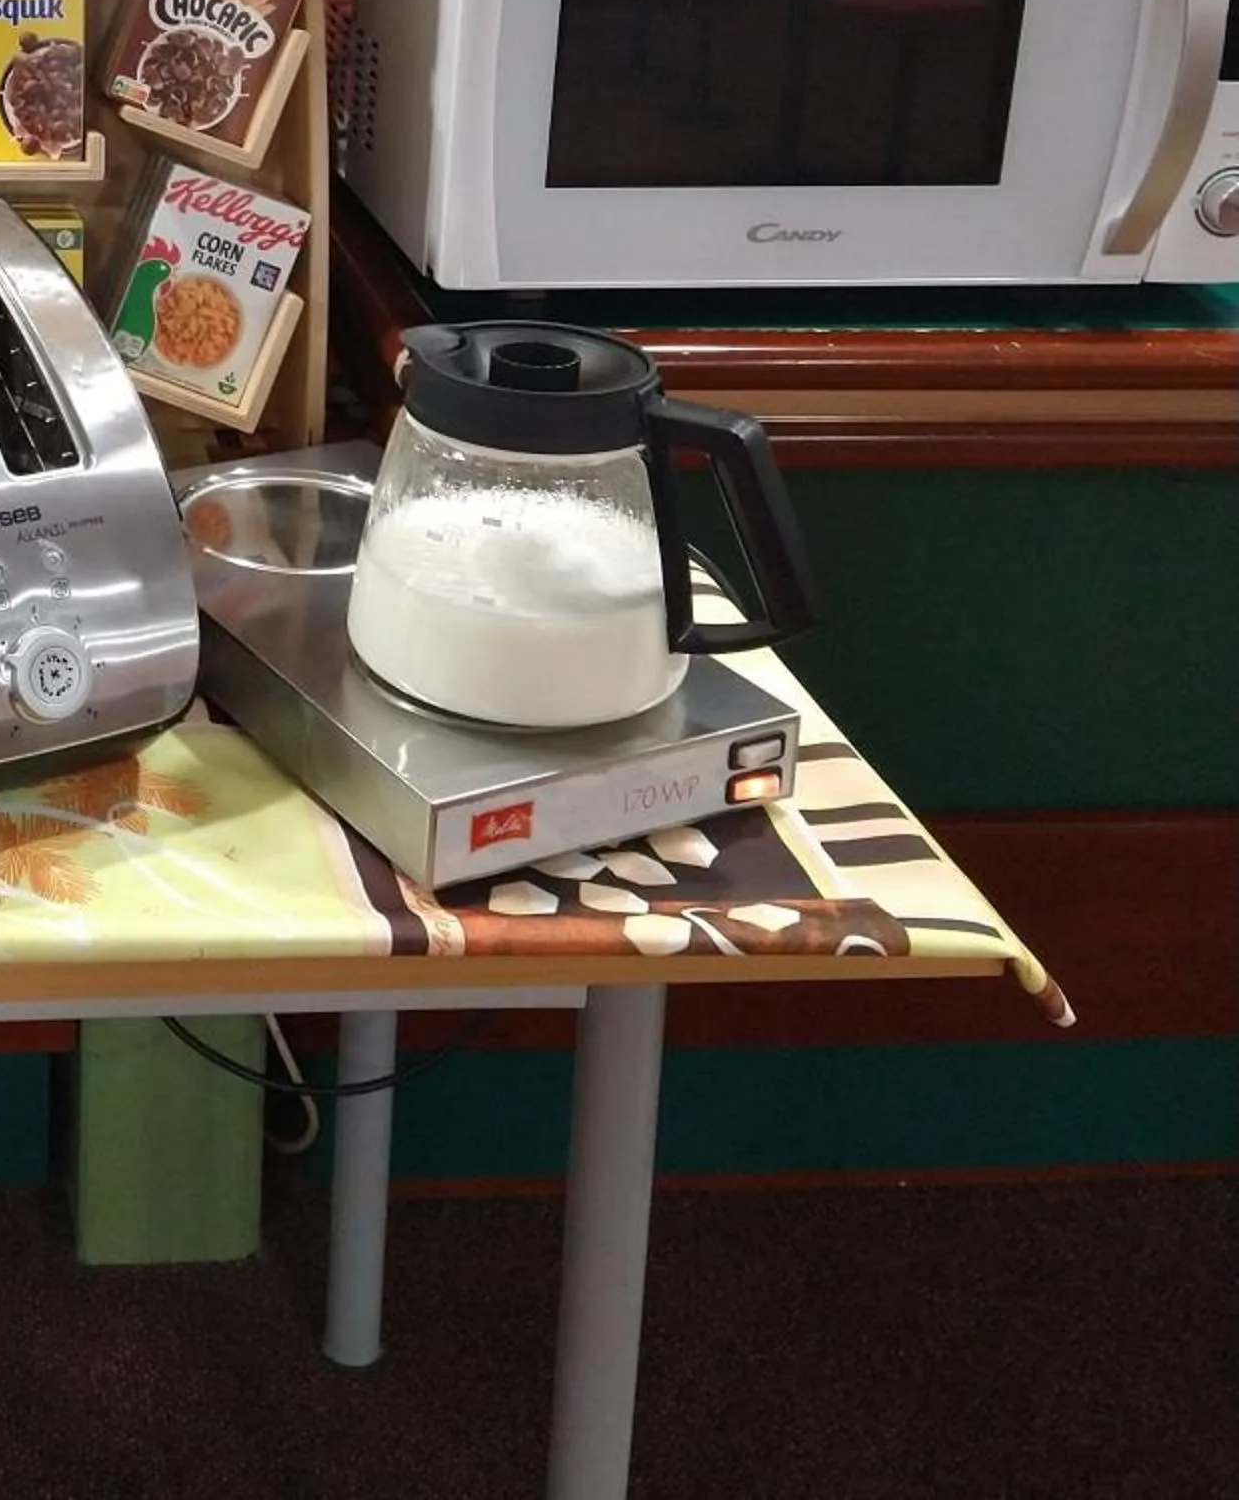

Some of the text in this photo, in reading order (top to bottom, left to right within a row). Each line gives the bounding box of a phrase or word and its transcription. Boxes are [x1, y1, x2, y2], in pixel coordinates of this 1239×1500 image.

[164, 177, 307, 251] Kellogg's
[191, 249, 238, 277] FLAKES
[197, 231, 245, 263] CORN
[623, 774, 700, 814] 170 WP
